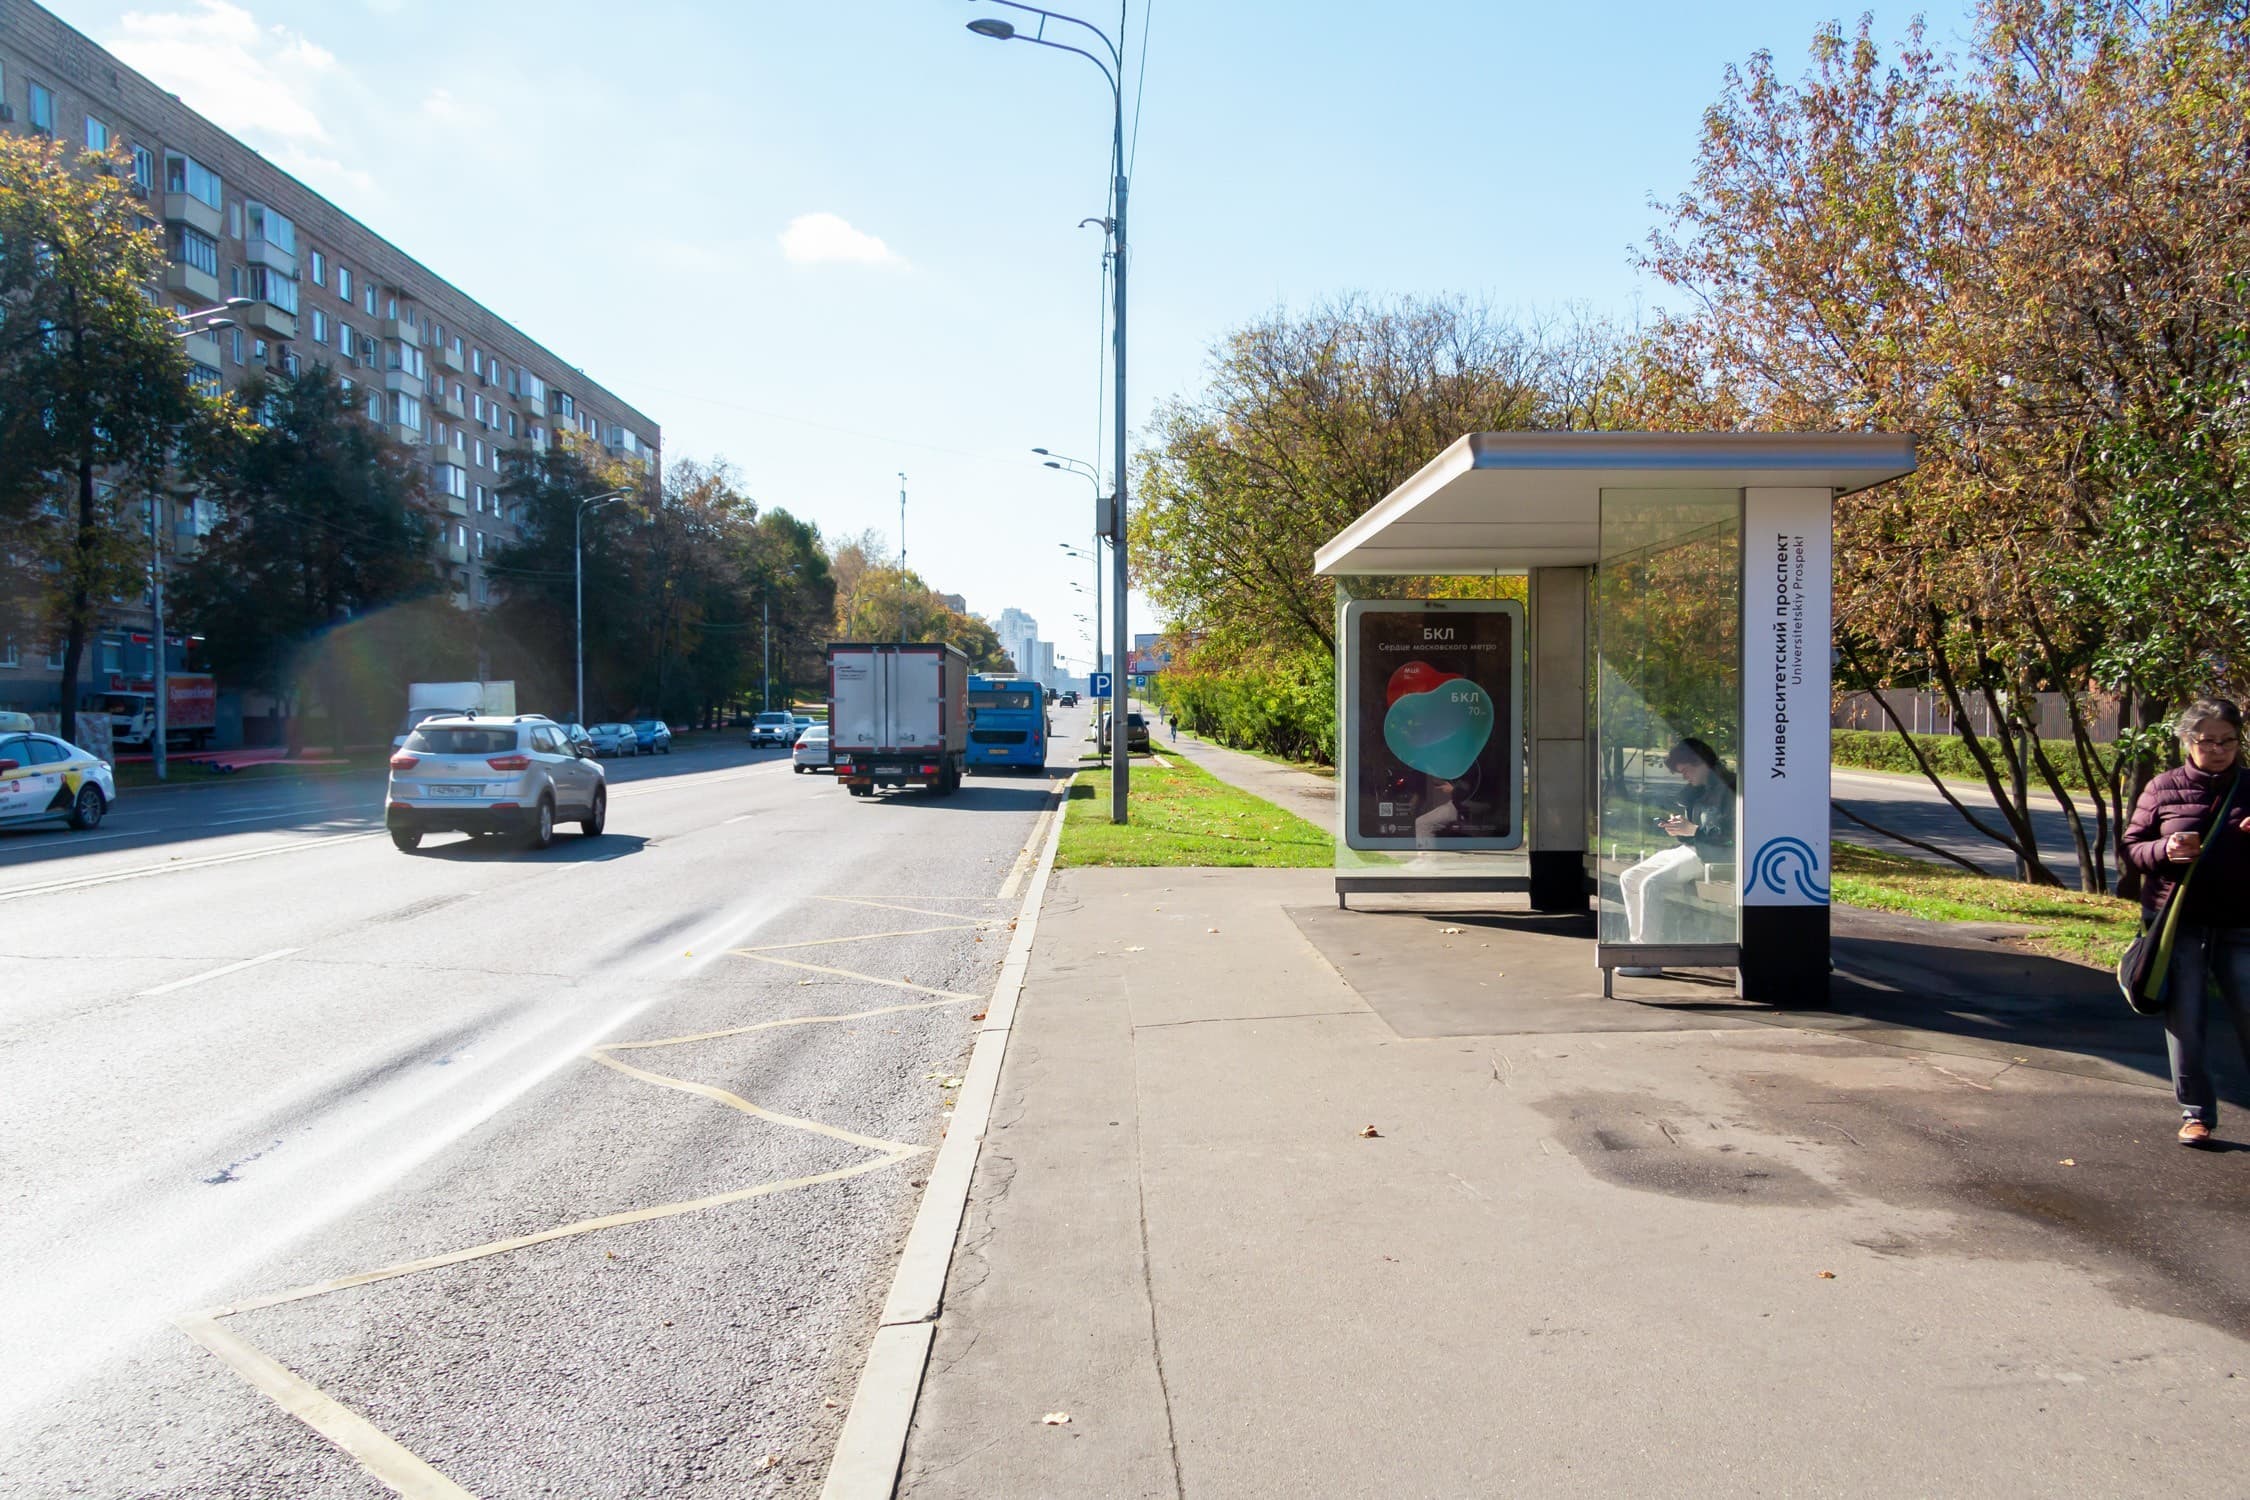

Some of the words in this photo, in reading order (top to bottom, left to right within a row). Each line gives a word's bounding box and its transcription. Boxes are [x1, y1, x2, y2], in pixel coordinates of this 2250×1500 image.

[1776, 533, 1791, 617] проспект
[1793, 536, 1806, 590] Prospekt
[1423, 627, 1454, 640] БКЛ
[1792, 591, 1806, 685] Universitetskiy
[1096, 675, 1110, 695] P
[1451, 692, 1479, 703] БКЛ
[1771, 622, 1789, 780] Университетский
